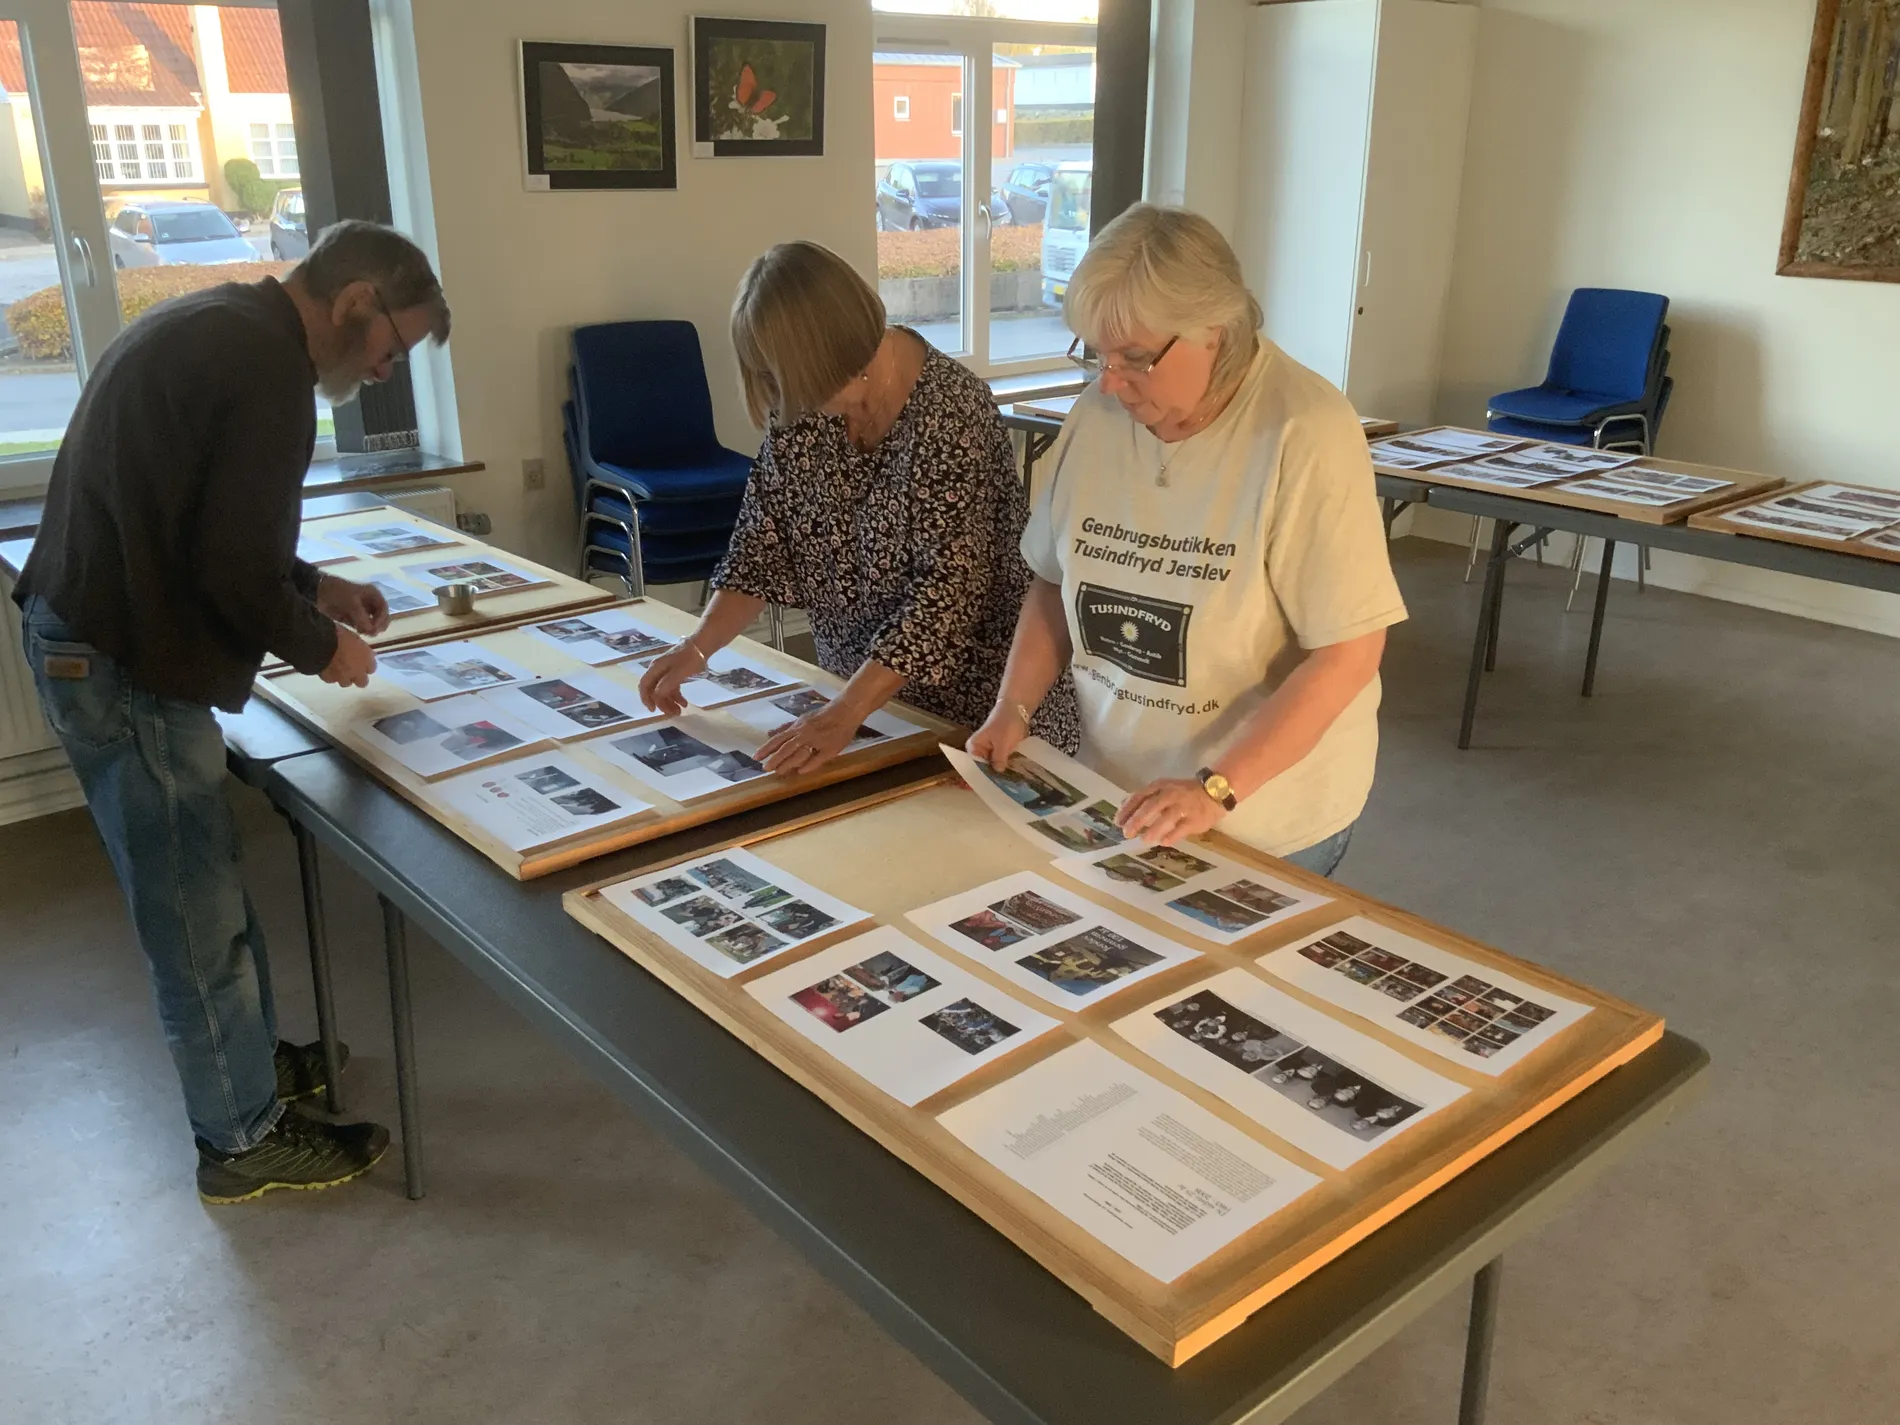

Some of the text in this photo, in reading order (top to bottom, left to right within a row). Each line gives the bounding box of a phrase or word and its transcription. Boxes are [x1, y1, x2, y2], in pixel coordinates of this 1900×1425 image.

[1081, 517, 1237, 556] Genbrugsbutikken
[1074, 538, 1231, 582] Tusindfryd Jerslev
[1089, 604, 1172, 632] TUSINDFRYD
